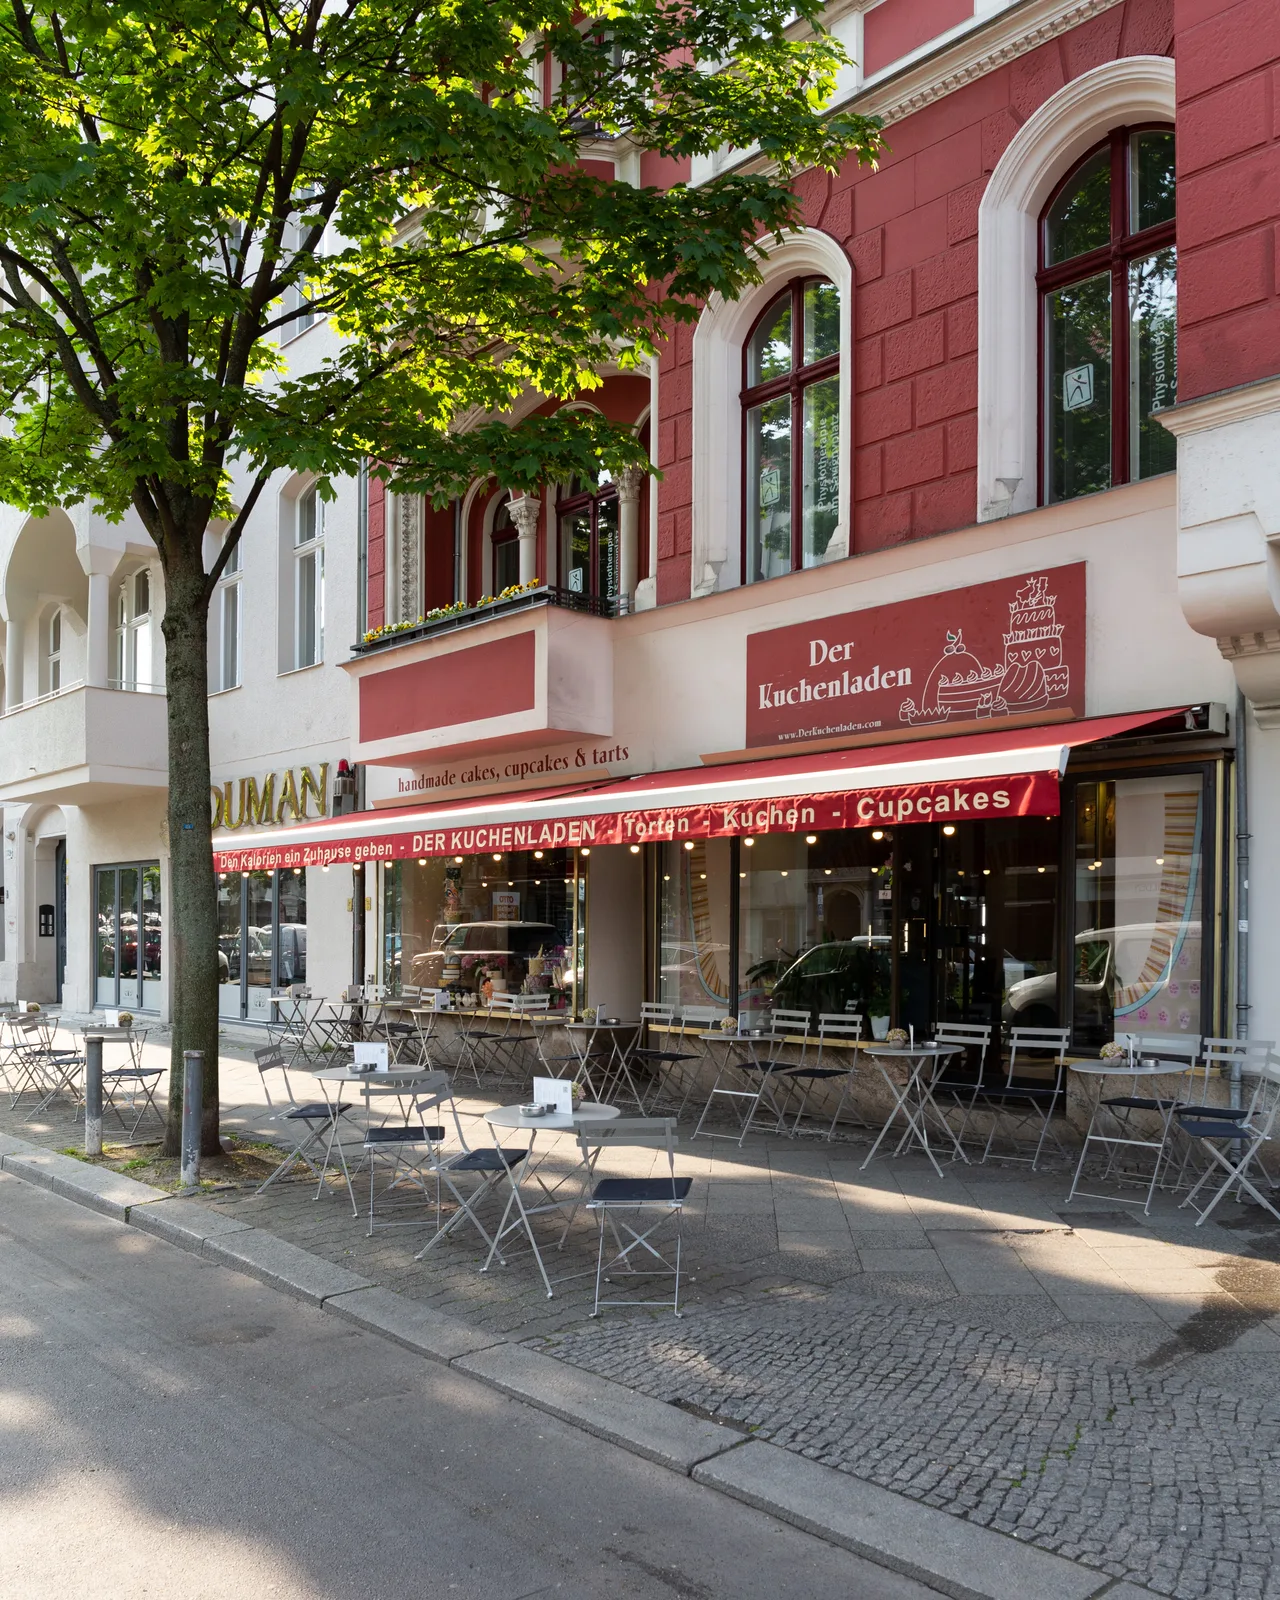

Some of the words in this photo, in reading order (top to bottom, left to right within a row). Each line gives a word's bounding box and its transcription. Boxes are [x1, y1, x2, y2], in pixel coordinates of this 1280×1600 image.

[1152, 309, 1168, 411] Physiotherap
[817, 418, 828, 510] Physiotherapie
[809, 639, 855, 667] Der
[758, 665, 913, 710] Kuchenladen
[778, 720, 882, 741] www.DerKuchenladen.com
[398, 770, 456, 793] handmade
[460, 765, 500, 783] cakes,
[504, 754, 569, 780] cupcakes
[575, 748, 586, 768] &
[593, 746, 629, 765] tarts
[221, 855, 238, 868] Den
[240, 851, 282, 867] Kalorien
[284, 850, 300, 864] ein
[303, 845, 351, 863] Zuhause
[355, 843, 393, 860] geben
[412, 832, 446, 853] DER
[451, 820, 596, 849] KUCHENLADEN
[624, 815, 689, 837] Torten
[723, 805, 815, 829] Kuchen
[857, 788, 1011, 822] Cupcakes
